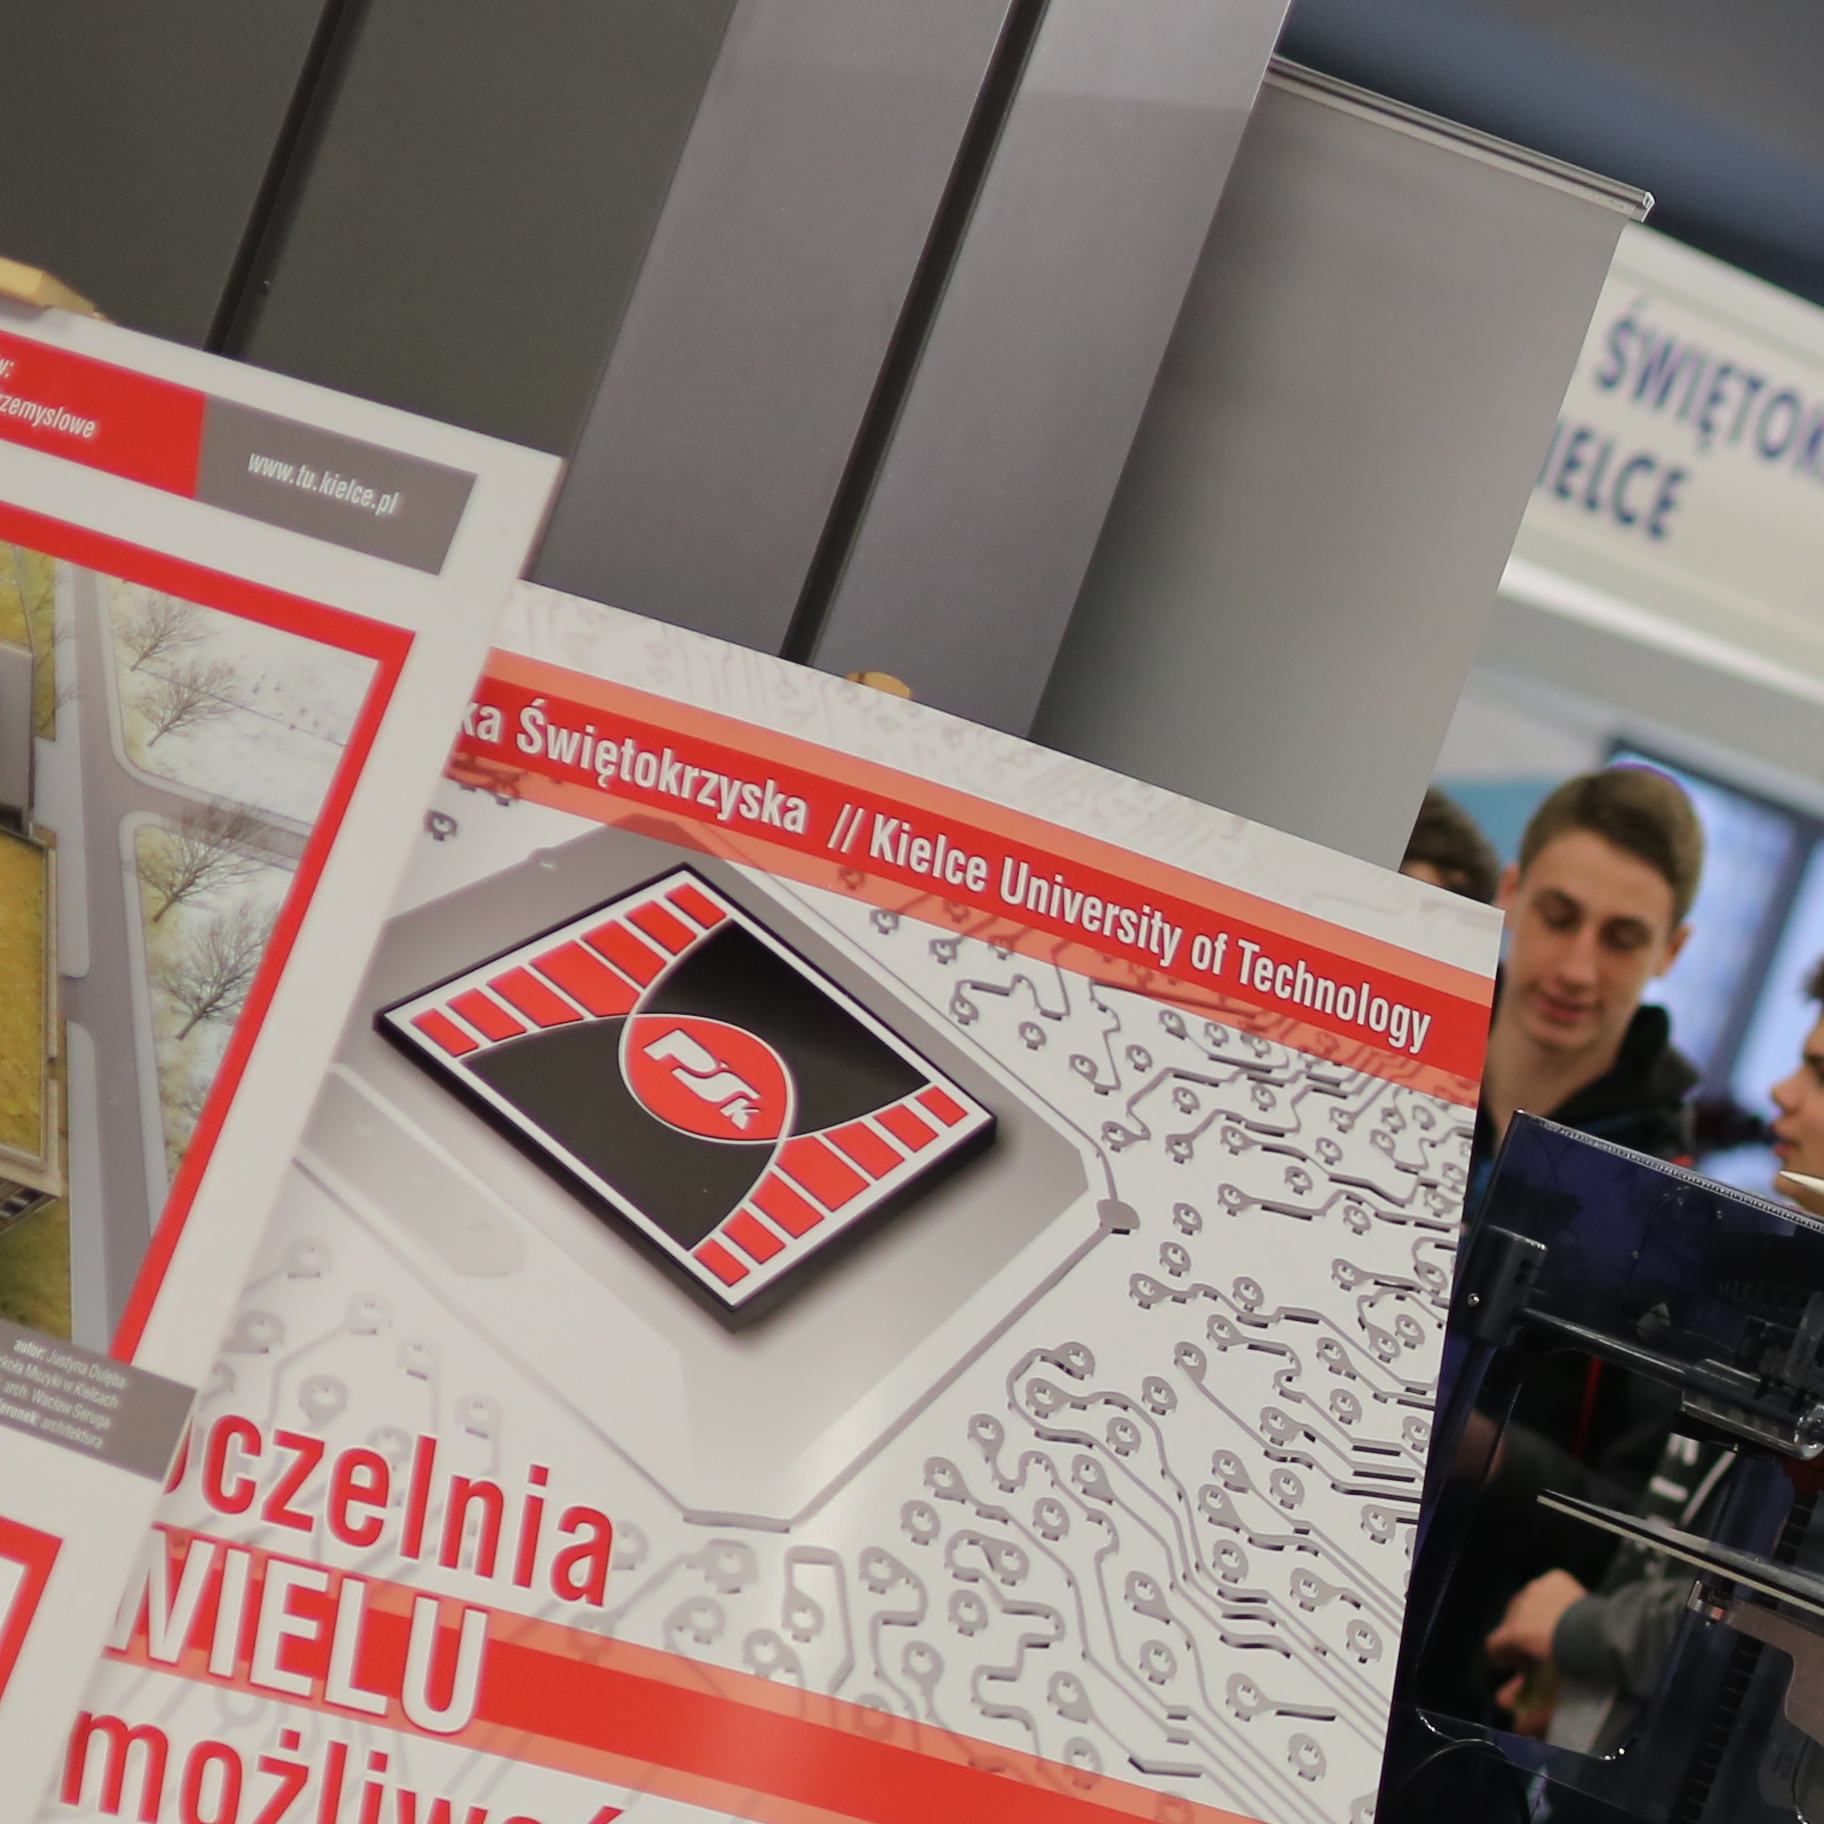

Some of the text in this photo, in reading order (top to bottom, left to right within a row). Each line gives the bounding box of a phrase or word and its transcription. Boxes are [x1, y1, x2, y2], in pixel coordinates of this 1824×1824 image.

[247, 449, 400, 518] www.tu.kielce.pl
[1536, 418, 1690, 545] IELCE
[514, 696, 808, 835] Świętokrzyska
[869, 813, 988, 894] Kielce
[1000, 856, 1183, 962] University
[1190, 931, 1228, 978] of
[1237, 937, 1433, 1054] Technology
[46, 1350, 89, 1376] Justyna
[165, 1414, 616, 1607] czelnia
